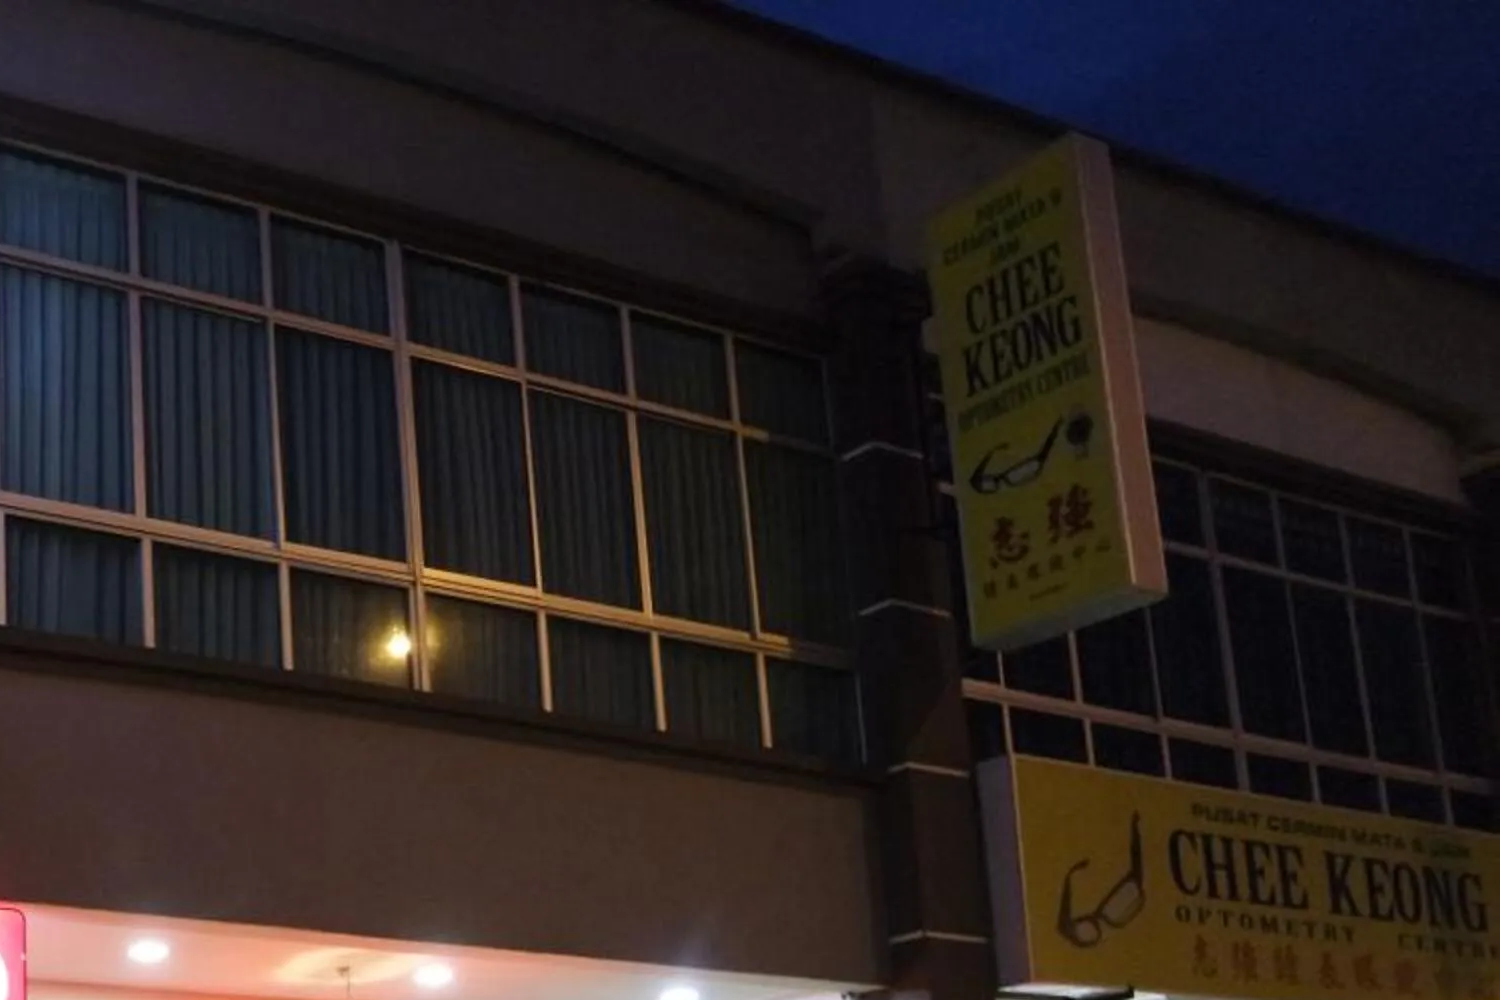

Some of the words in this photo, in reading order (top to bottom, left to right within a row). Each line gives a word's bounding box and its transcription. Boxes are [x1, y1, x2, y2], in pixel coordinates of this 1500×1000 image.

[965, 241, 1065, 334] CHEE
[962, 295, 1083, 398] KEONG
[1168, 829, 1309, 911] CHEE
[1324, 851, 1489, 933] KEONG
[1174, 905, 1356, 943] OPTOMETRY
